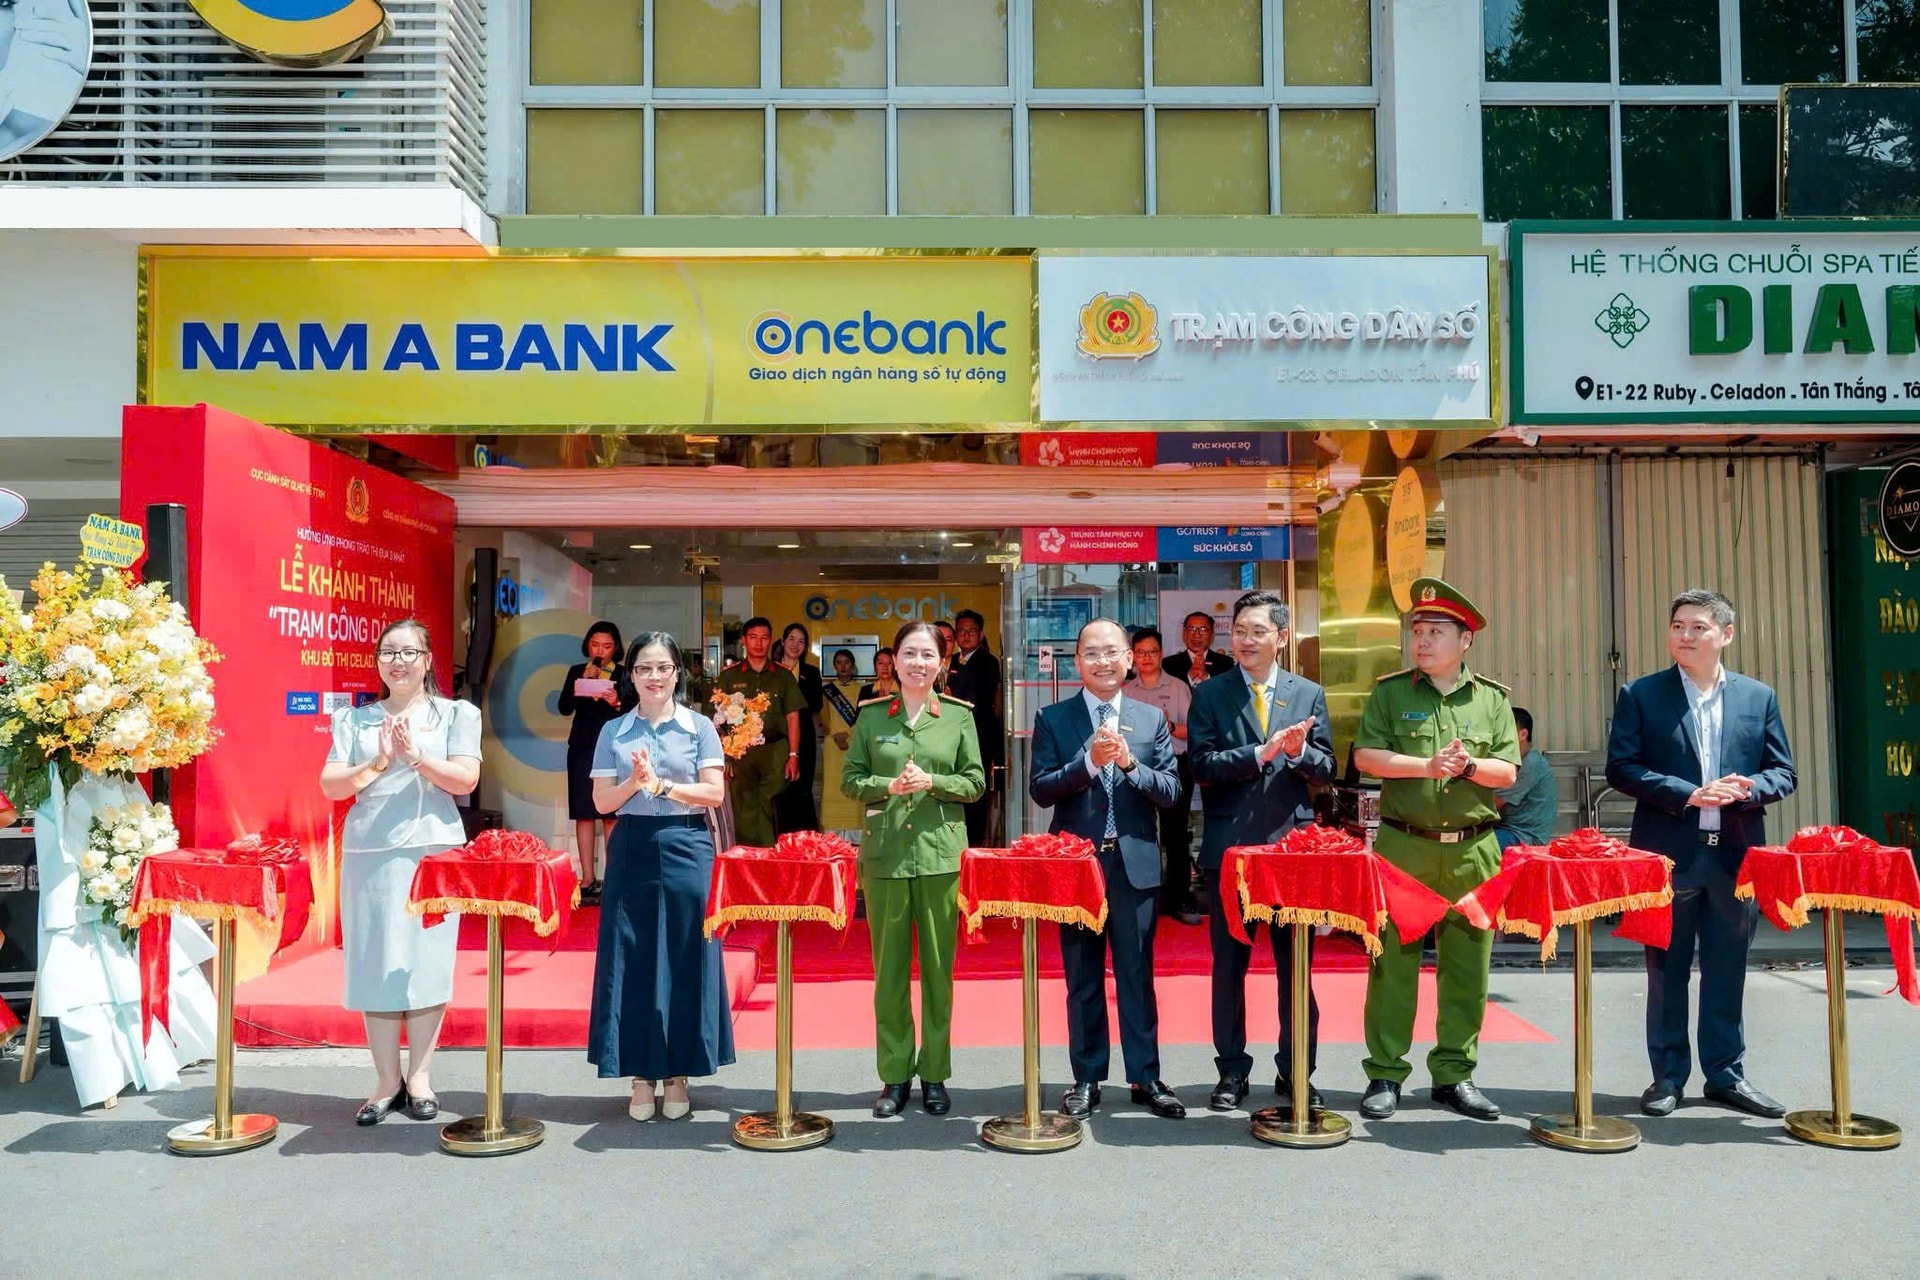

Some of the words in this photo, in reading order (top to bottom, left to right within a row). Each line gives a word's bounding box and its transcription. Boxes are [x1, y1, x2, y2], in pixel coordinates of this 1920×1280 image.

[1571, 248, 1606, 277] HỆ
[1619, 245, 1718, 274] THỐNG
[1727, 244, 1812, 274] CHUỖI
[1823, 253, 1873, 274] SPA
[1171, 311, 1257, 348] TRẠM
[1261, 304, 1360, 342] CÔNG
[1362, 304, 1432, 342] DÂN
[1434, 300, 1482, 341] SỐ
[182, 321, 368, 371] NAM
[383, 322, 440, 371] A
[455, 323, 676, 372] BANK
[749, 367, 787, 380] Giao
[792, 366, 826, 383] dịch
[832, 366, 872, 383] ngân
[878, 366, 918, 383] hàng
[923, 364, 942, 380] số
[946, 368, 962, 383] tự
[965, 367, 1006, 383] động
[1446, 361, 1481, 384] PHÚ
[1653, 383, 1697, 404] Ruby
[1711, 382, 1786, 400] Celadon
[1800, 382, 1829, 399] Tân
[1834, 377, 1887, 403] Thắng
[89, 515, 110, 531] NAM
[112, 522, 118, 534] A
[119, 523, 141, 540] BANK
[280, 543, 304, 593] LỄ
[308, 559, 366, 603] KHÁNH
[369, 571, 415, 611] THÀNH
[327, 605, 368, 643] CÔNG
[371, 611, 392, 644] DÂ
[301, 649, 321, 667] KHU
[335, 652, 349, 670] THỊ
[349, 653, 377, 668] CELAD
